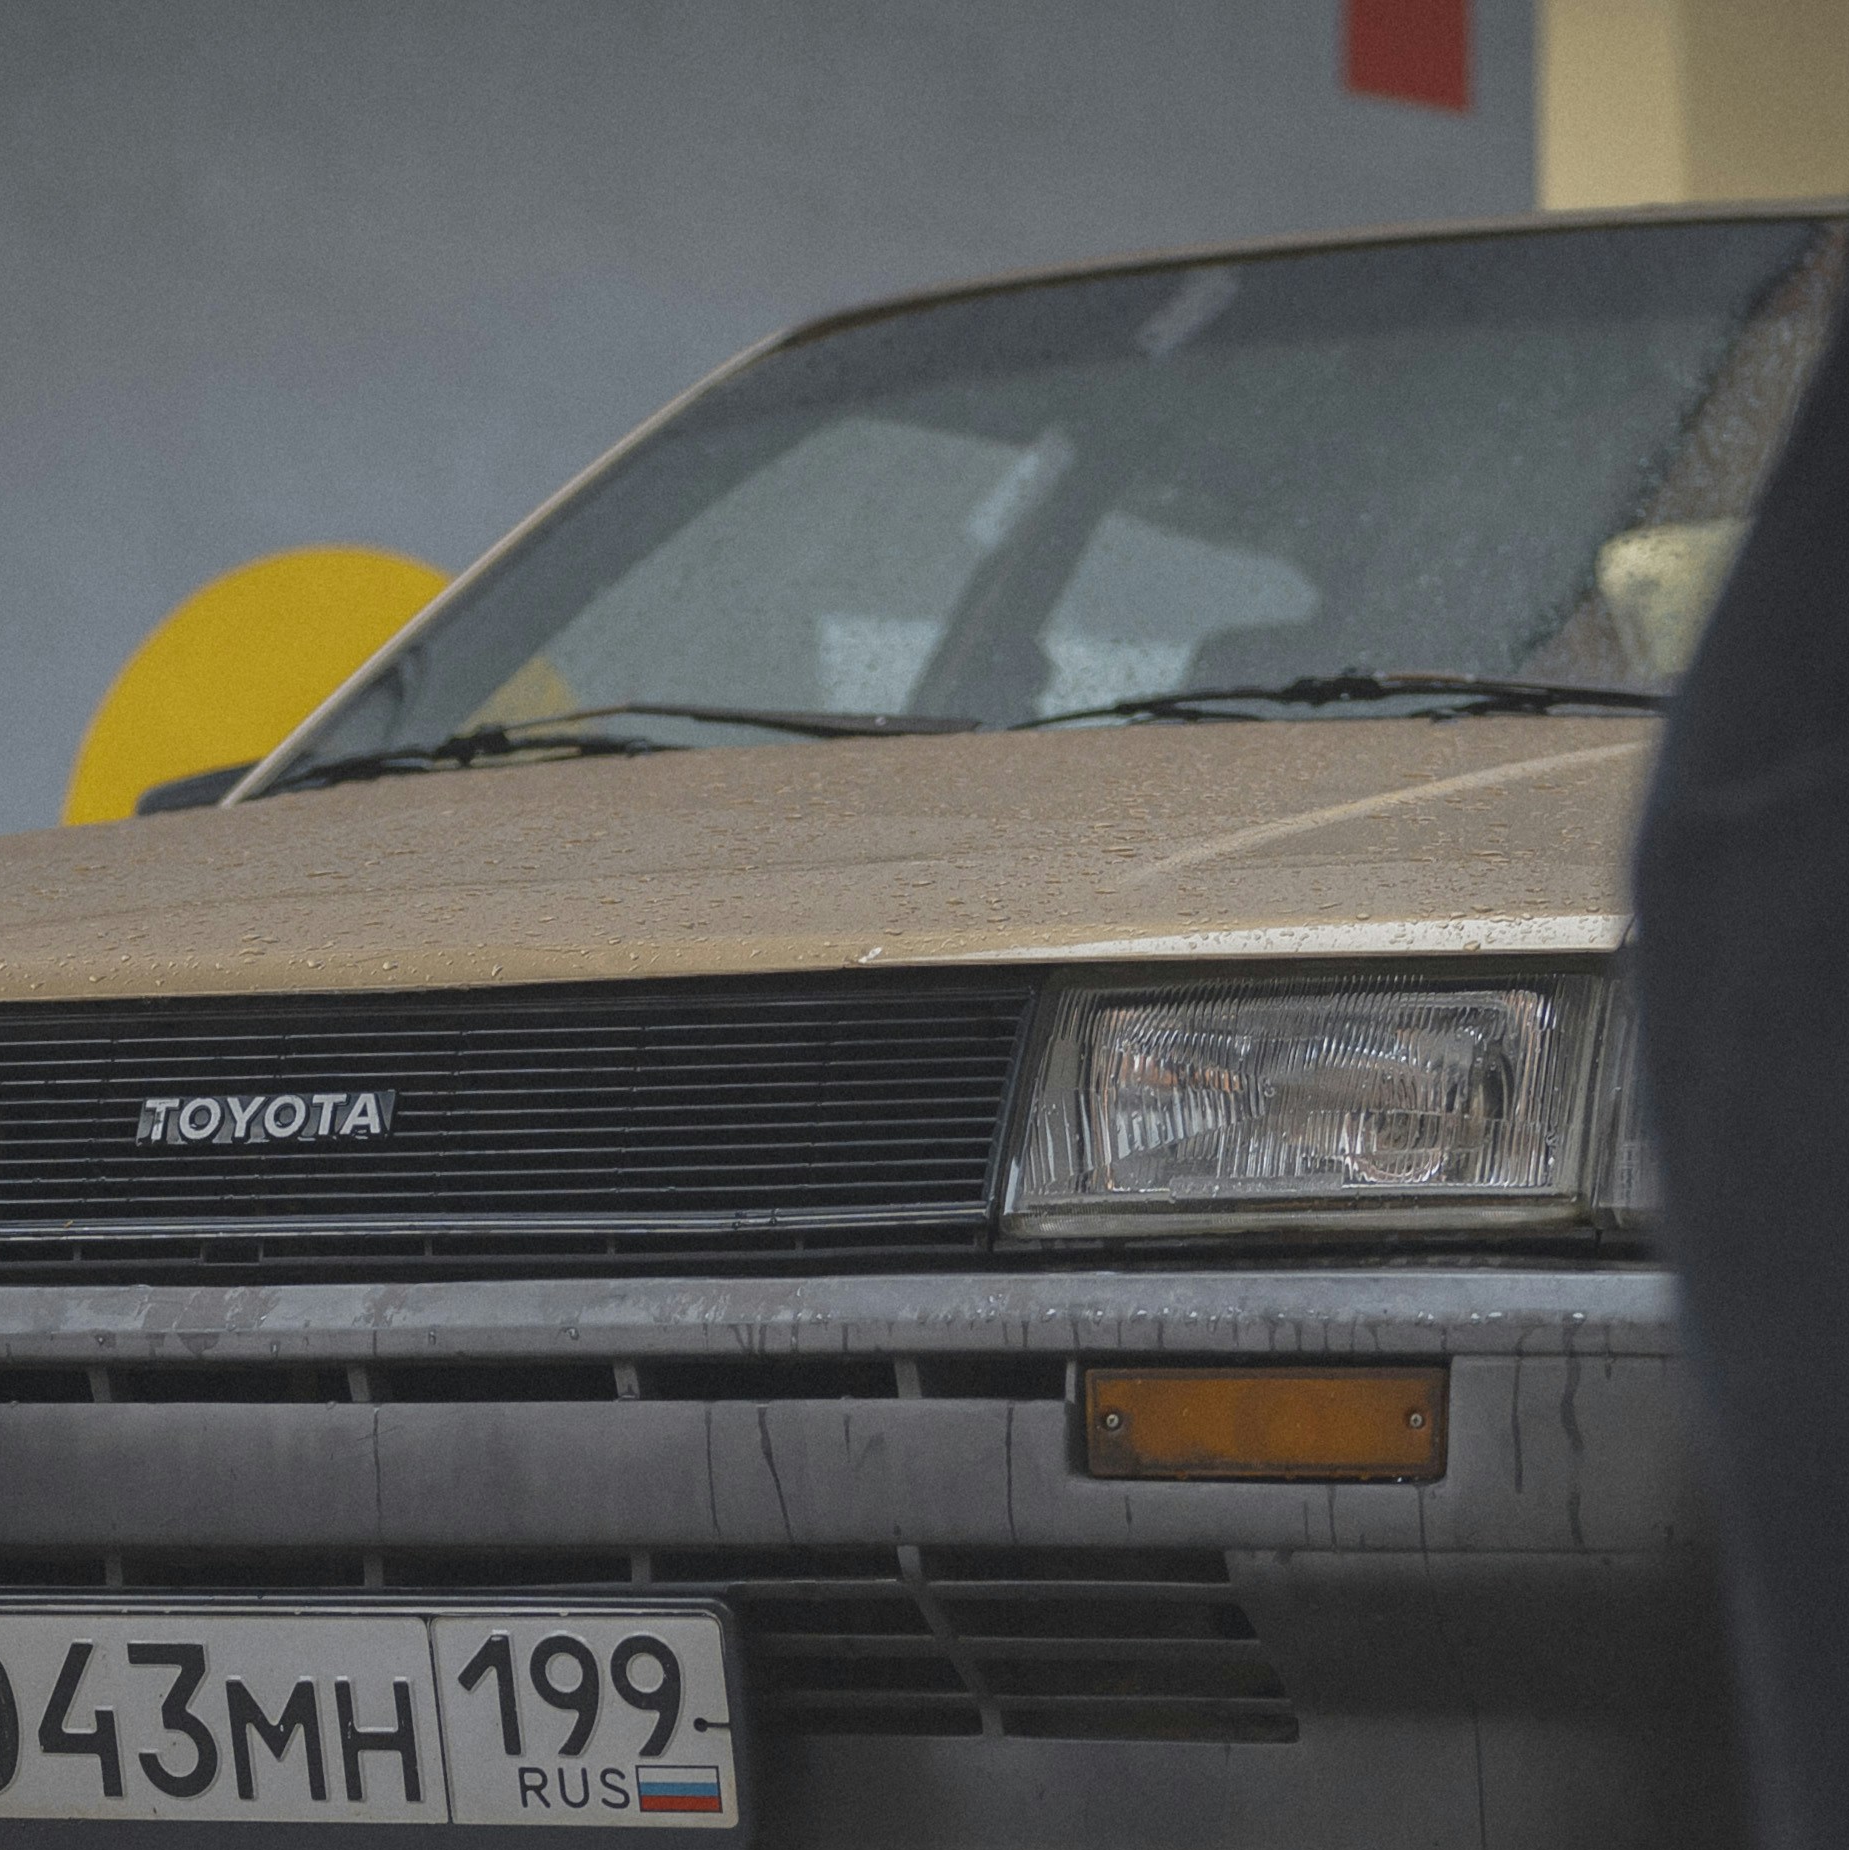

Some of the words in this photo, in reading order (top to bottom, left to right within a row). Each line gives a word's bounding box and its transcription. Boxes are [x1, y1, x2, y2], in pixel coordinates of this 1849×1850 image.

[145, 1092, 382, 1141] TOYOTA
[456, 1631, 681, 1758] 199
[518, 1765, 632, 1810] RUS
